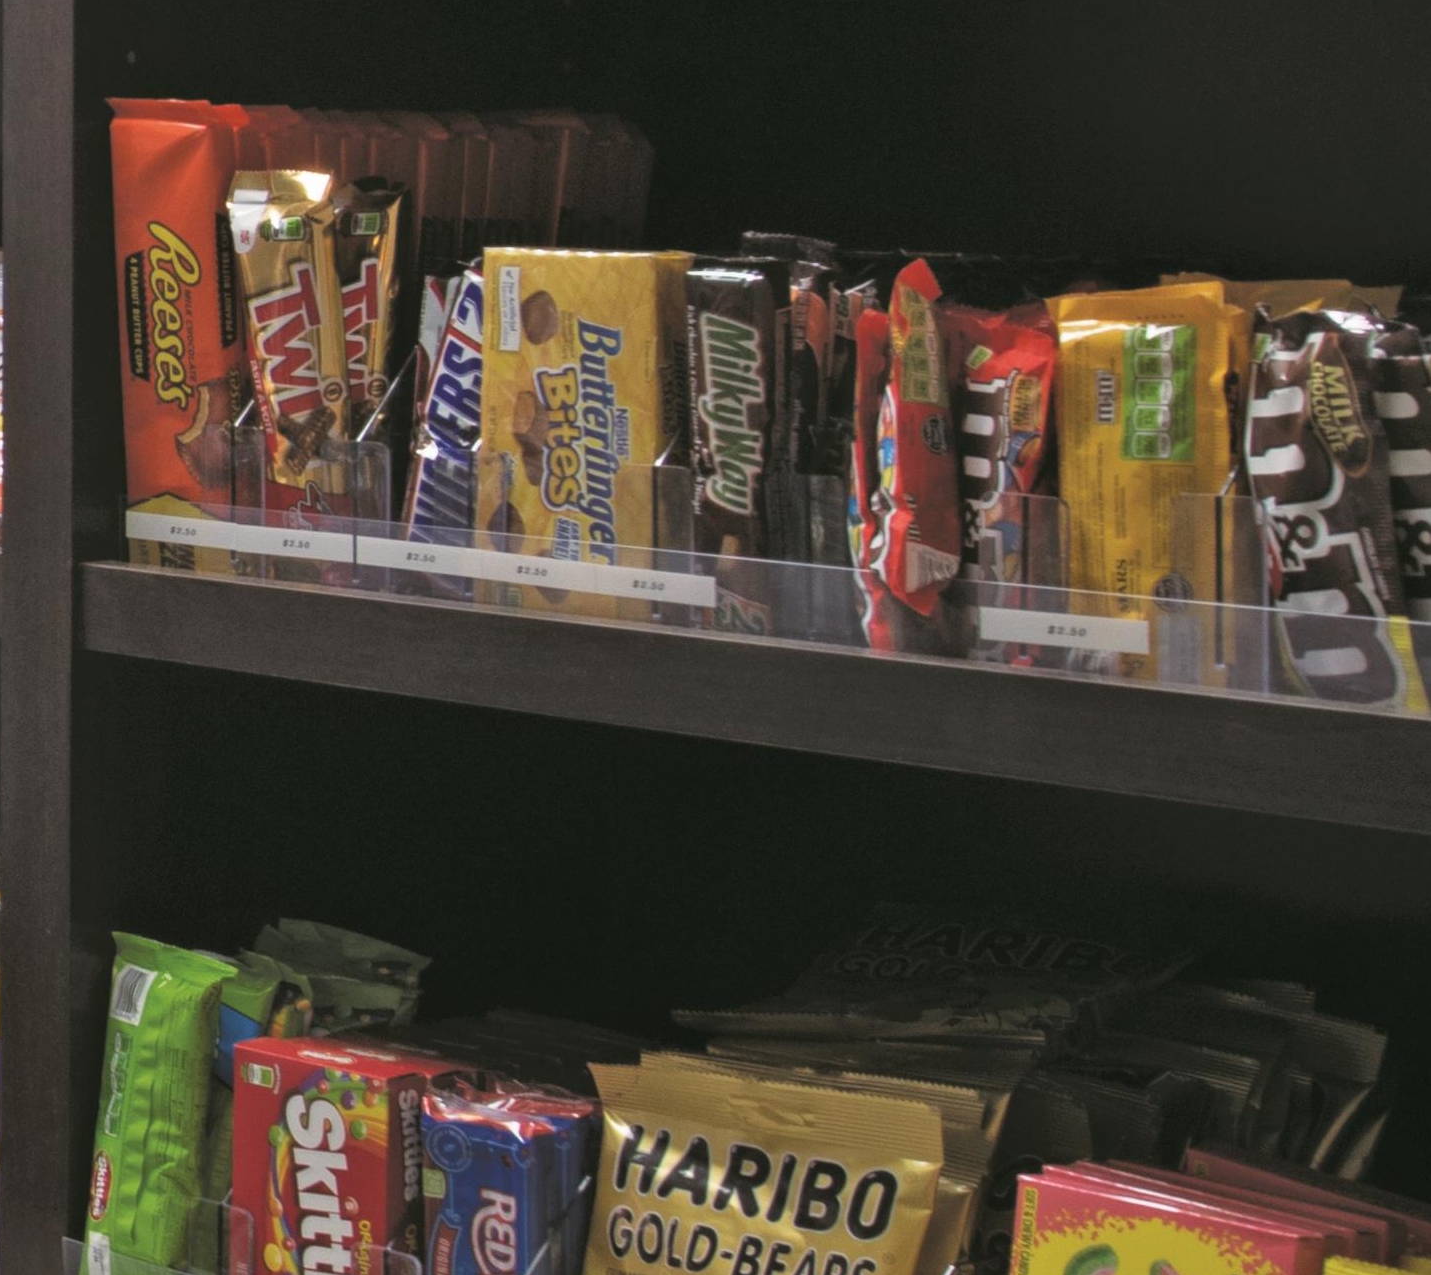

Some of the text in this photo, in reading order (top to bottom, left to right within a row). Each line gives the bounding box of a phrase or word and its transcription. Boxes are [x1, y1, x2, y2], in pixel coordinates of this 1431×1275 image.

[129, 264, 144, 375] PEANUT BUTTER CUPS
[148, 221, 202, 411] Reese's
[533, 365, 581, 512] Bites
[575, 317, 623, 566] Butterfinger
[1309, 361, 1349, 458] CHOCOLATE
[1324, 363, 1366, 451] MILK
[631, 578, 666, 593] $2.50
[470, 1186, 518, 1273] RED
[612, 1122, 900, 1243] HARIBO
